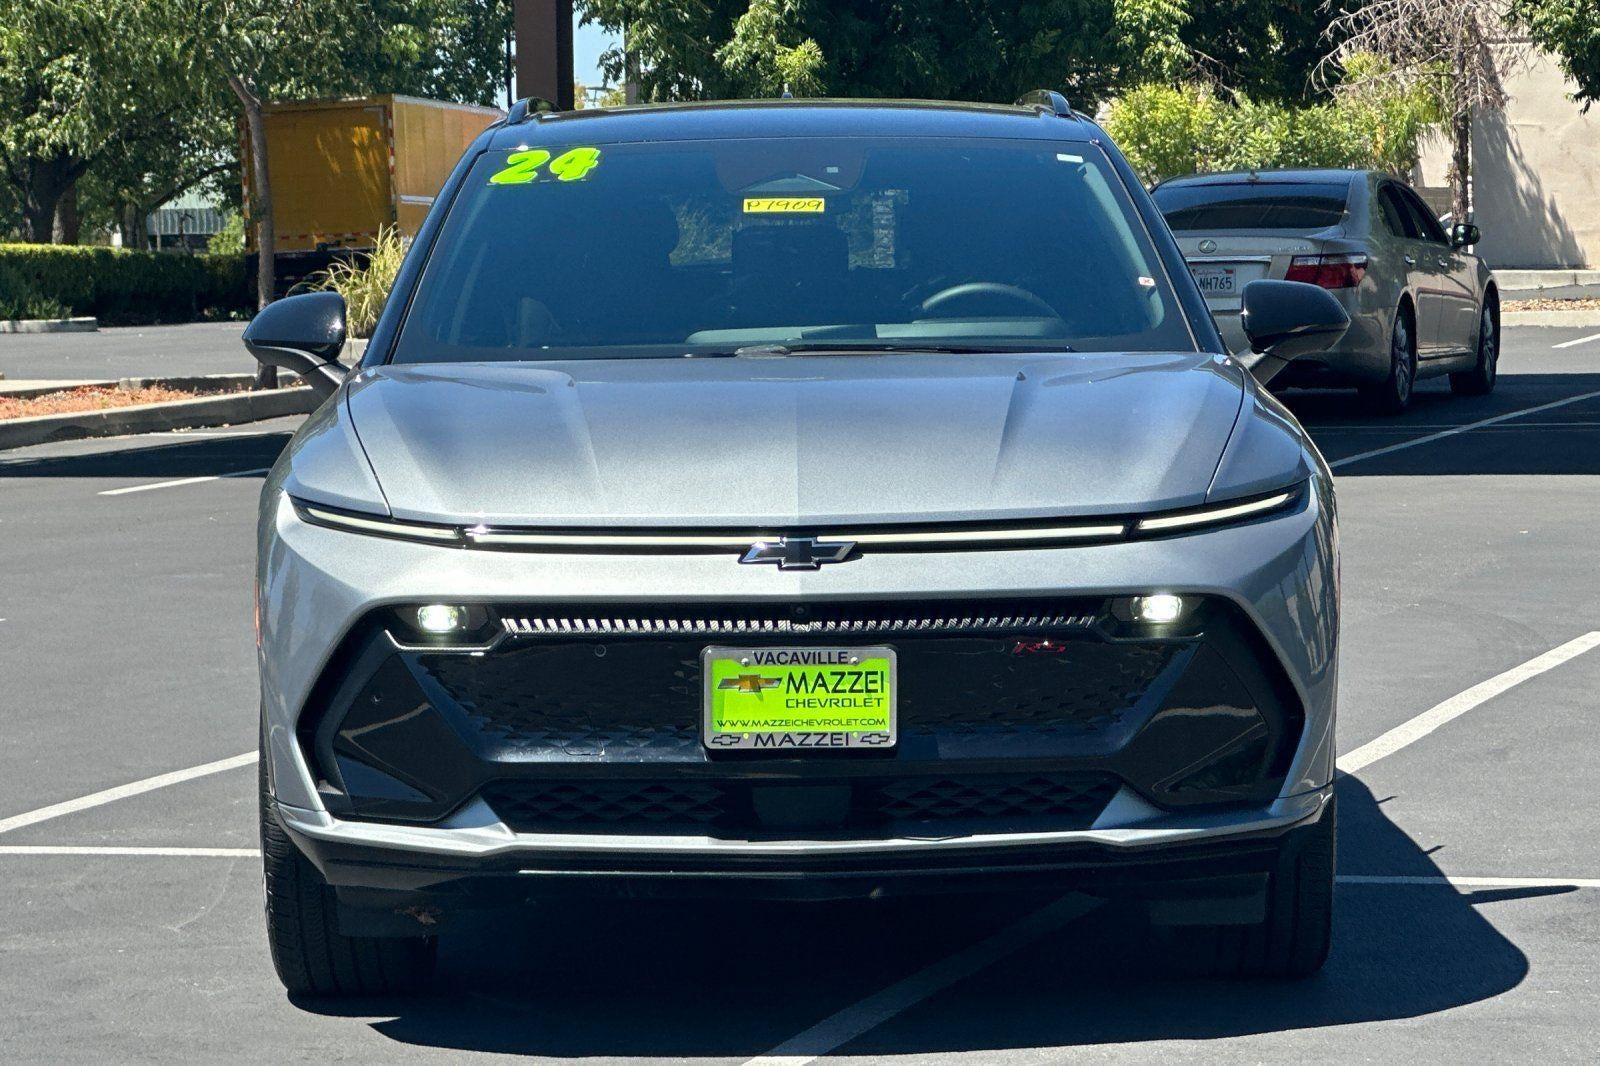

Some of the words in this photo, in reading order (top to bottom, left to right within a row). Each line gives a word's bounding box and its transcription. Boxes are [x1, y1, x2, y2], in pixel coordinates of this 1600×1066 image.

[490, 148, 600, 184] 24
[746, 200, 823, 211] P7909
[753, 651, 849, 665] VACAVILLE
[785, 670, 885, 694] MAZZEI
[785, 697, 884, 708] CHEVROLET
[717, 718, 886, 728] WWW.MAZZEICHEVROLET.COM
[753, 732, 849, 747] MAZZEI
